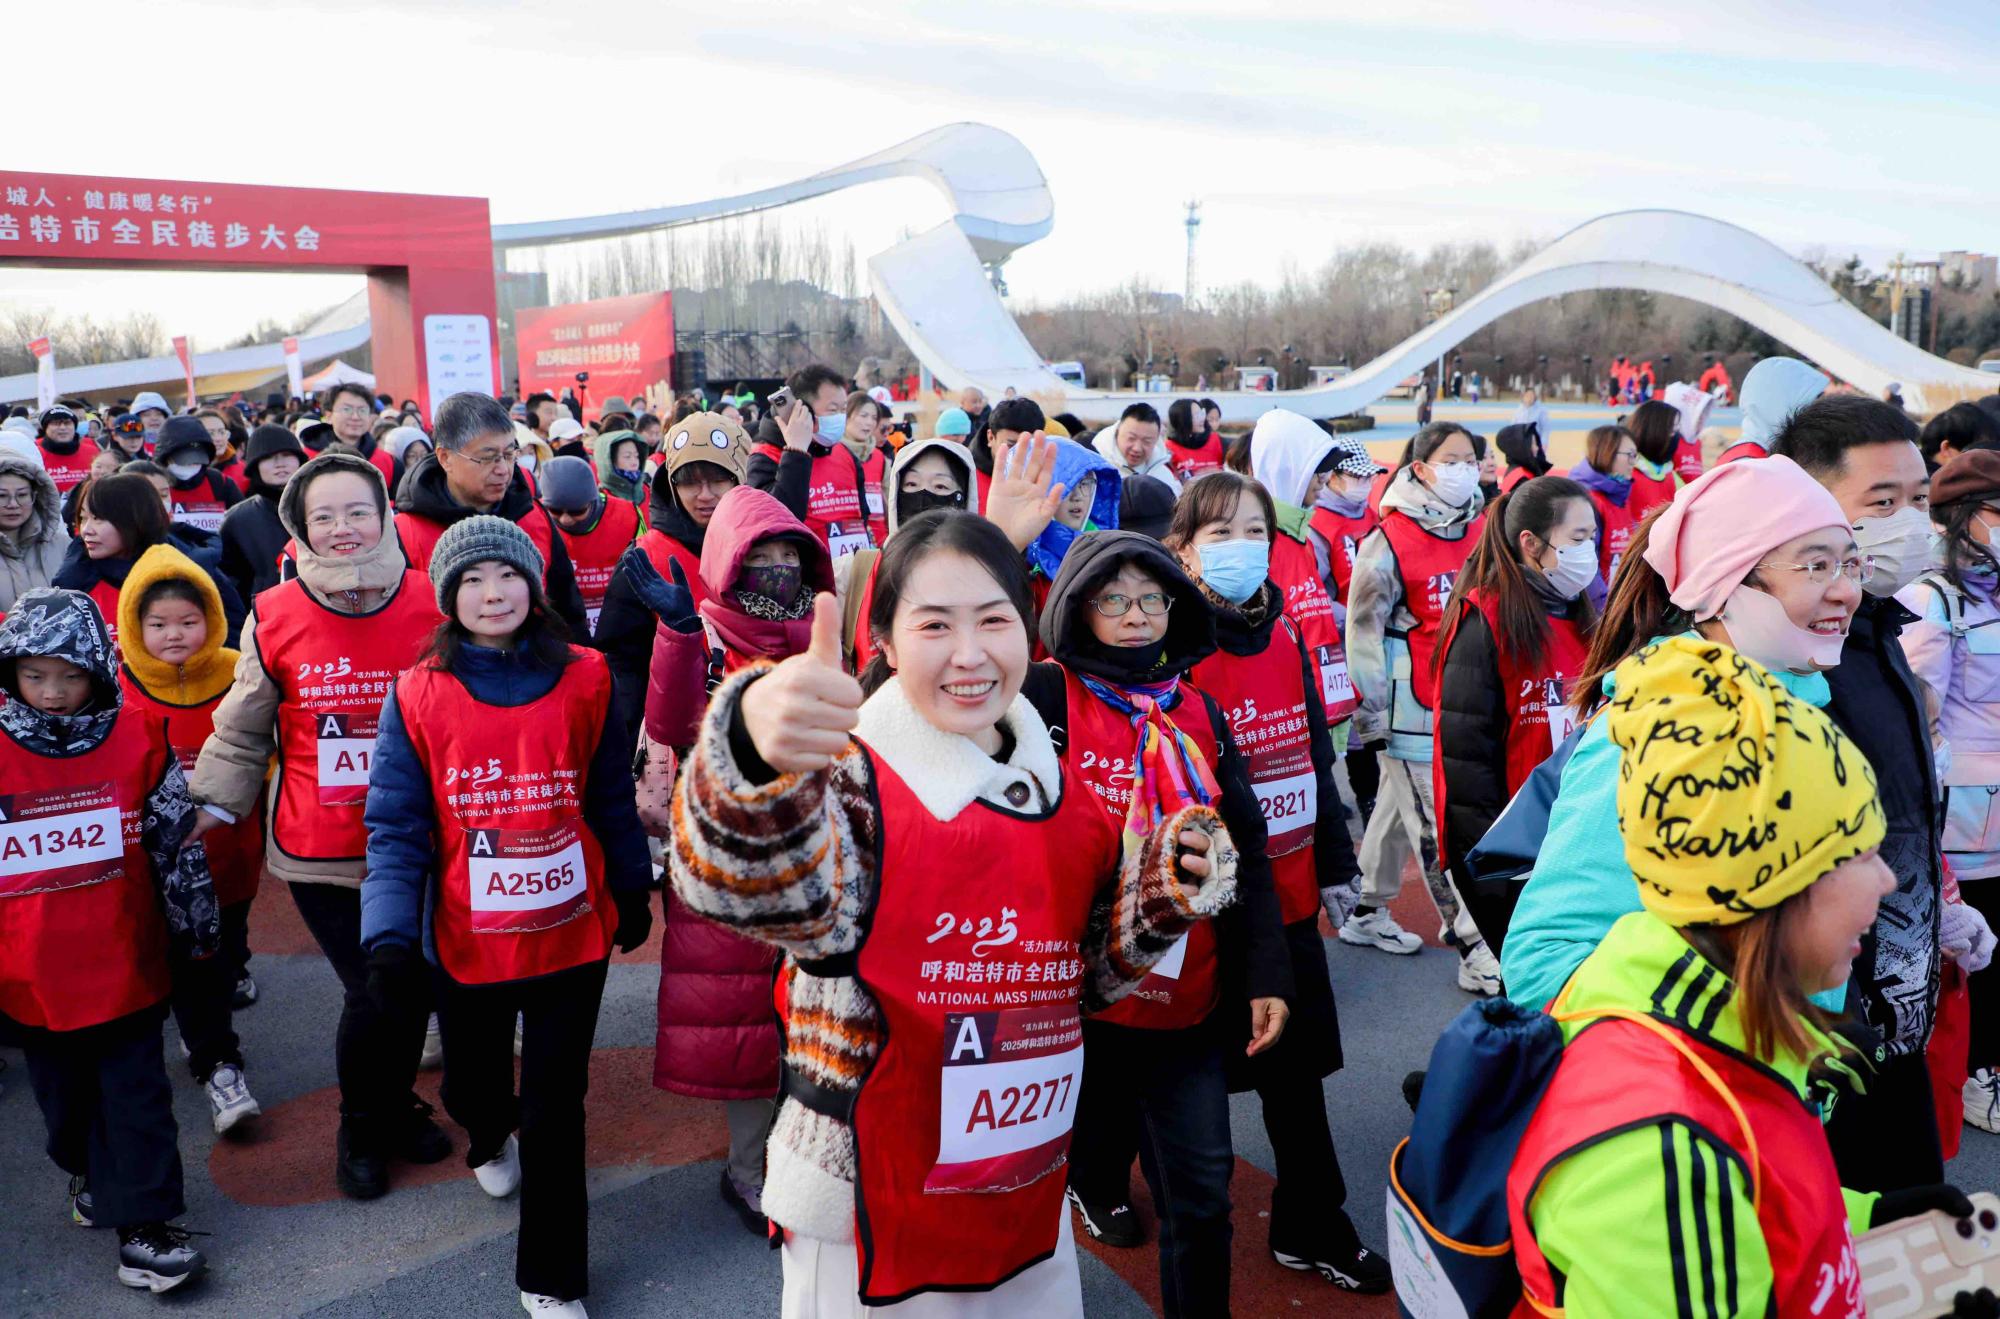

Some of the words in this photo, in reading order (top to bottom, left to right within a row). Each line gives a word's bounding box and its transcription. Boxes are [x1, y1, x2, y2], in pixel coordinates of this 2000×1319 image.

[0, 186, 213, 214] 城人·健康暖冬行”
[174, 503, 185, 514] A
[829, 522, 842, 537] A
[1440, 574, 1453, 593] A
[1320, 646, 1329, 665] A
[297, 656, 352, 684] 2025
[1328, 671, 1352, 693] A173
[1548, 681, 1560, 704] A
[341, 698, 366, 706] MASS
[321, 715, 343, 737] A
[1253, 742, 1275, 757] MASS
[445, 757, 503, 790] 2025
[1083, 780, 1134, 804] 和浩特
[493, 804, 520, 816] MASS
[522, 801, 553, 813] HIKING
[2, 823, 106, 861] A1342
[472, 830, 493, 855] A
[1656, 815, 1778, 860] Paris
[486, 860, 575, 896] A2565
[926, 906, 1018, 958] 2025
[917, 990, 989, 1006] NATIONAL
[993, 991, 1028, 1005] MASS
[1030, 988, 1066, 1002] HIKING
[950, 1016, 985, 1061] A
[965, 1072, 1074, 1135] A2277
